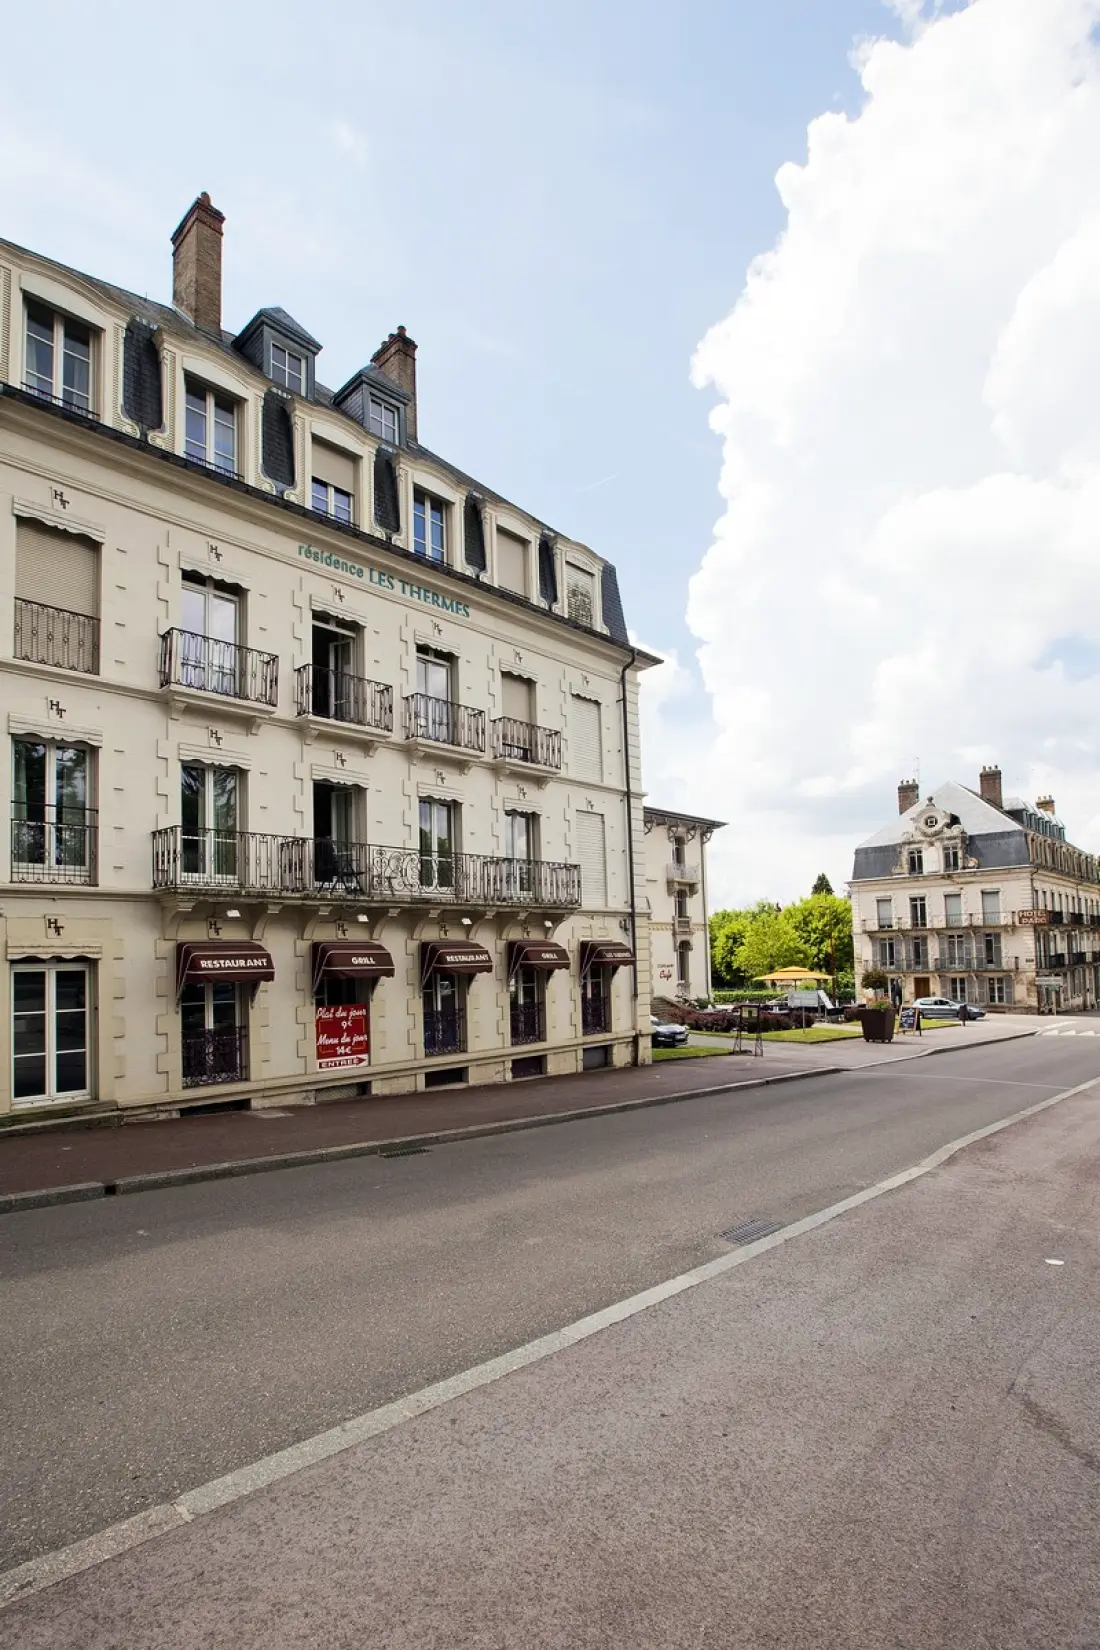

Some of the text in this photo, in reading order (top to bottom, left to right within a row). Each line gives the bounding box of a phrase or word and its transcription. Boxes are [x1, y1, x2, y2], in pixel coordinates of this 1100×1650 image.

[298, 545, 471, 618] résidence LES THERMES
[351, 956, 376, 965] GRILL
[446, 953, 489, 962] RESTAURANT
[541, 952, 558, 960] GRILL
[200, 958, 268, 969] RESTAURANT
[316, 1006, 367, 1020] Plat du jour
[317, 1031, 367, 1046] Menu du jour
